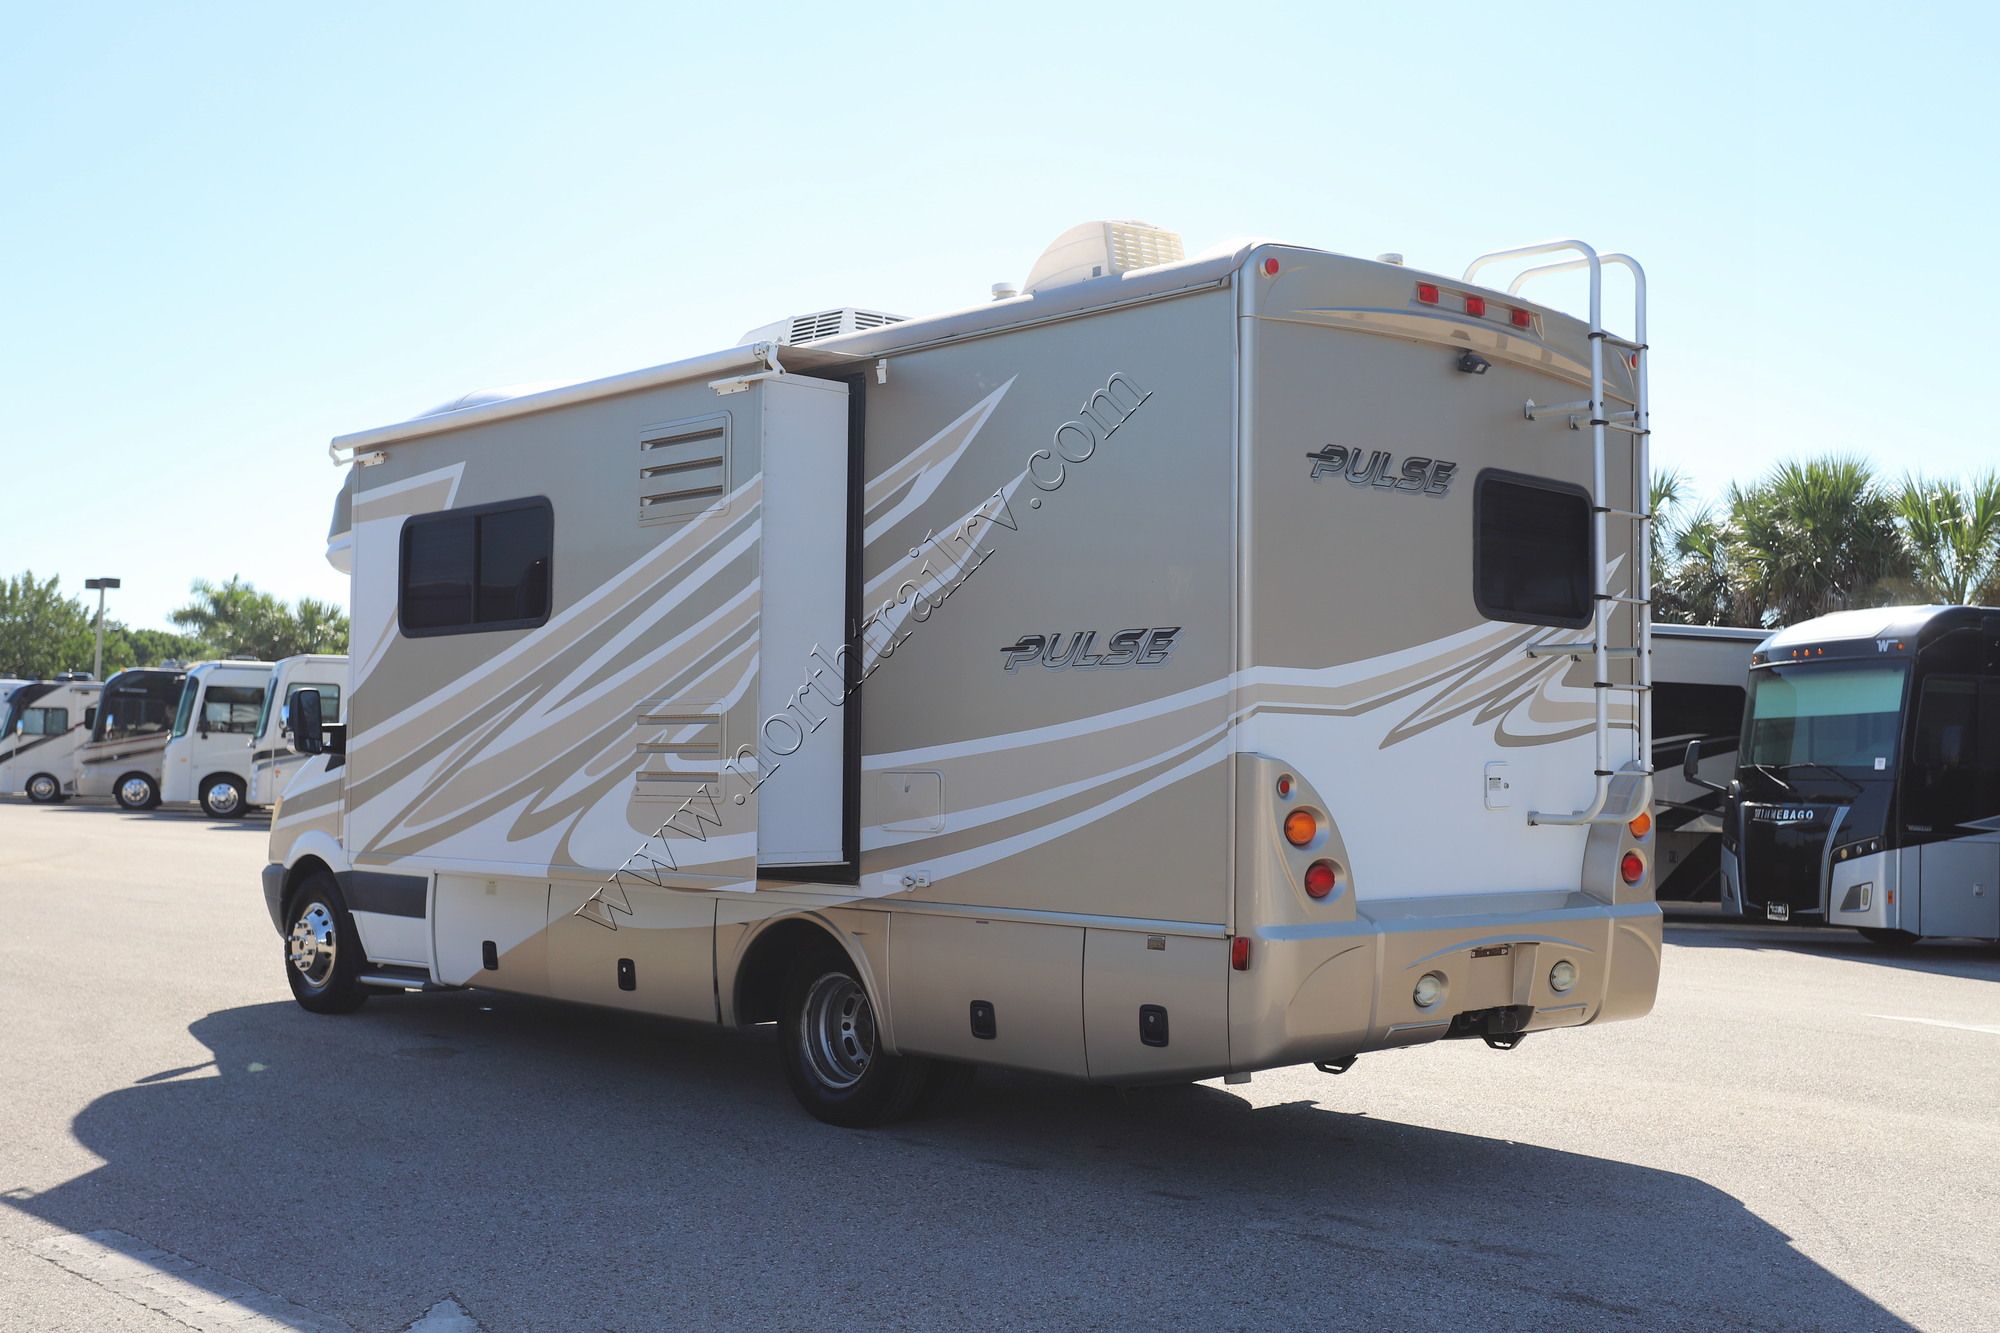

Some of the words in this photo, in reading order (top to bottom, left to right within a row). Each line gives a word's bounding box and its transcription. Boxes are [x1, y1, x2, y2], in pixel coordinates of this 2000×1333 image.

[1306, 444, 1457, 497] PULSE
[1000, 626, 1182, 673] PULSE
[1754, 808, 1814, 820] WINNEBAGO
